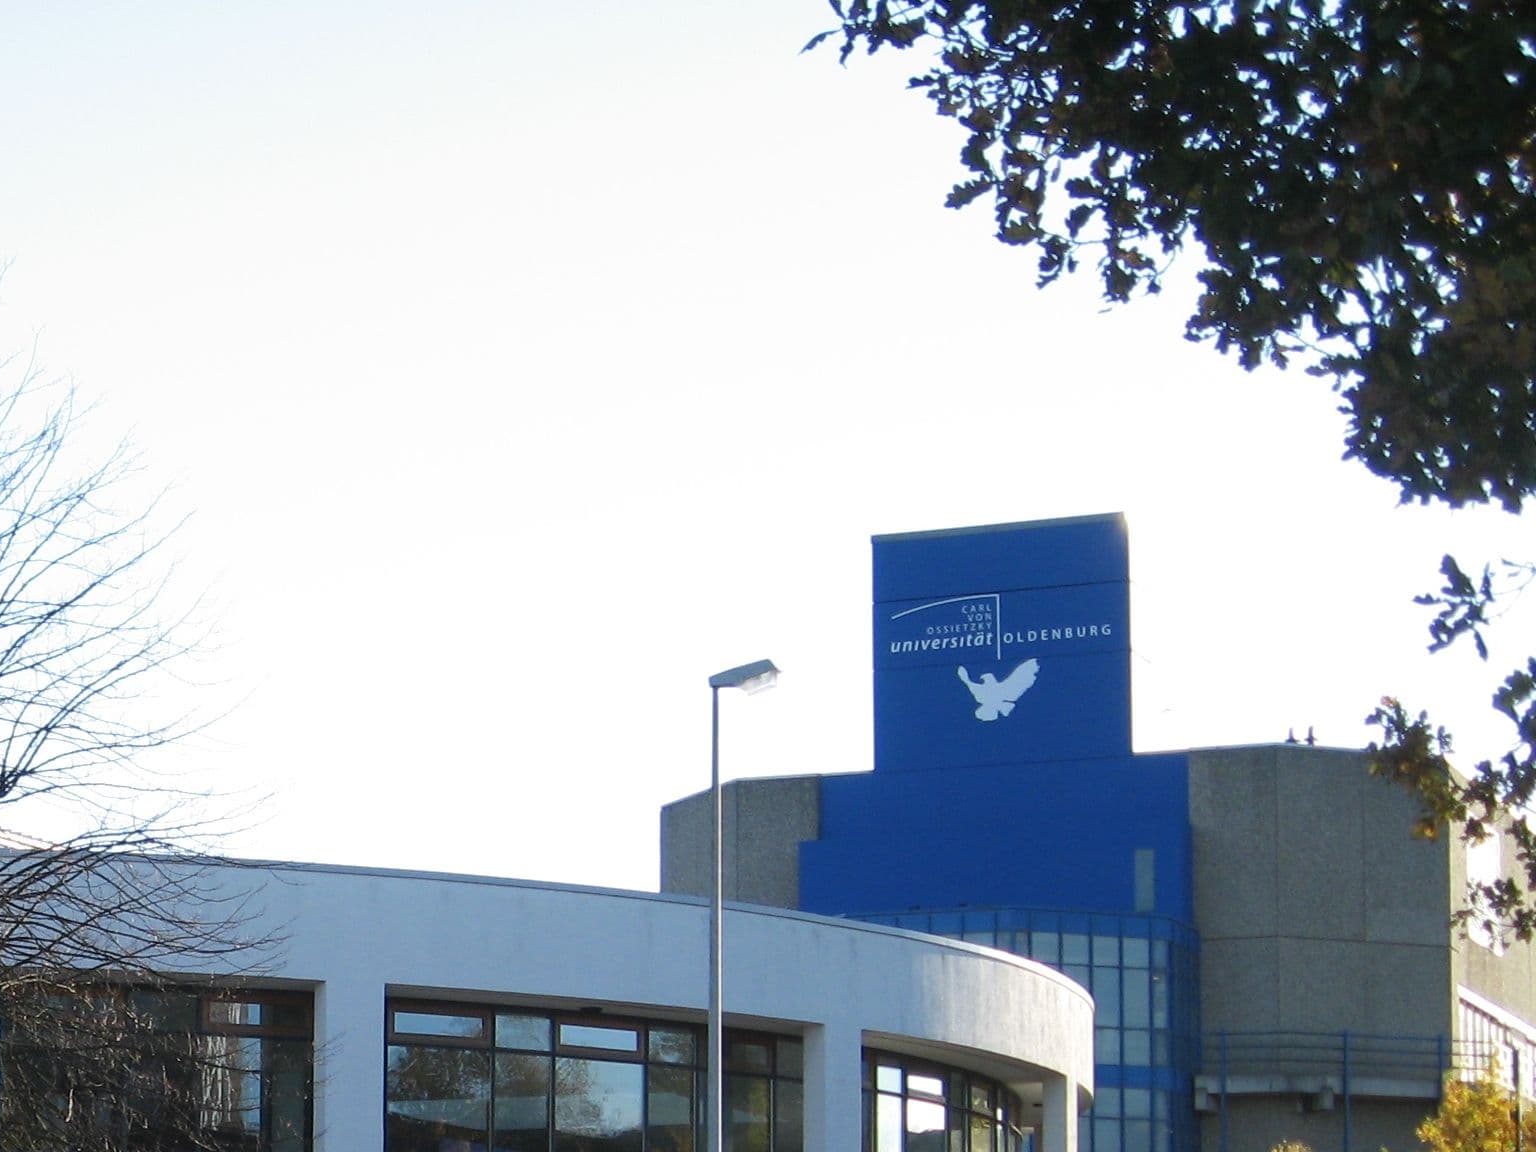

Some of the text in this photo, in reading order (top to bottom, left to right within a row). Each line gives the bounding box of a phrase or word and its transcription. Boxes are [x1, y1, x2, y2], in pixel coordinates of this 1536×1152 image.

[962, 604, 992, 614] CARL
[967, 613, 992, 622] VON
[927, 622, 992, 634] OSSIETZKY
[891, 624, 1111, 653] universität OLDENBURG
